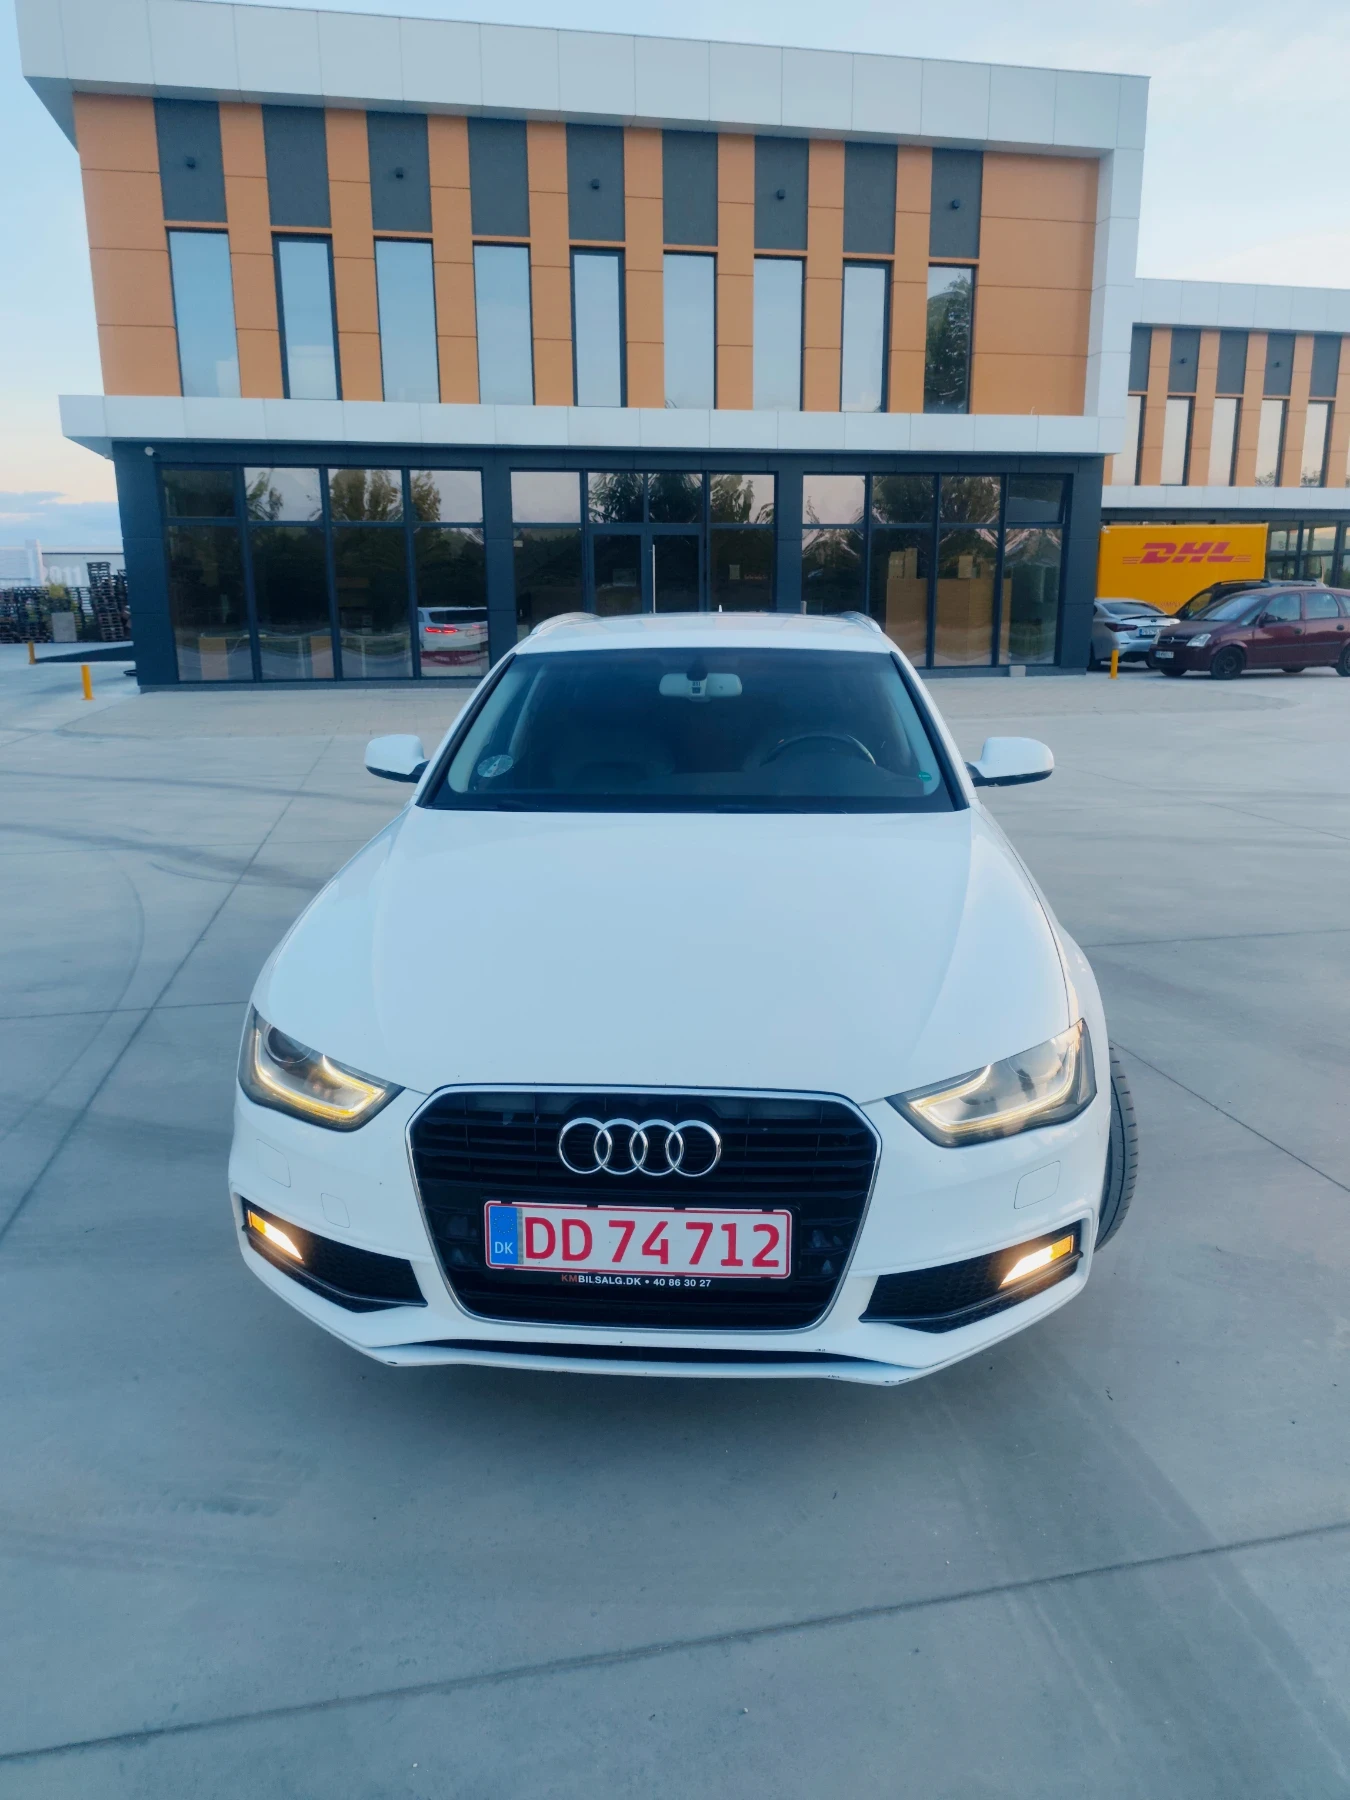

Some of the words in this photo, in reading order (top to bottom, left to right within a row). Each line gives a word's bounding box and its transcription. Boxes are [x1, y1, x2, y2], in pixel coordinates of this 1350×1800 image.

[1139, 541, 1235, 564] DHL
[494, 1241, 514, 1255] DK
[525, 1216, 593, 1262] DD
[608, 1219, 669, 1265] 74
[685, 1222, 780, 1268] 712
[561, 1274, 642, 1286] KMBILSALG.DK
[653, 1278, 666, 1287] 40
[668, 1278, 681, 1287] 86
[683, 1278, 697, 1288] 30
[699, 1278, 712, 1288] 27
